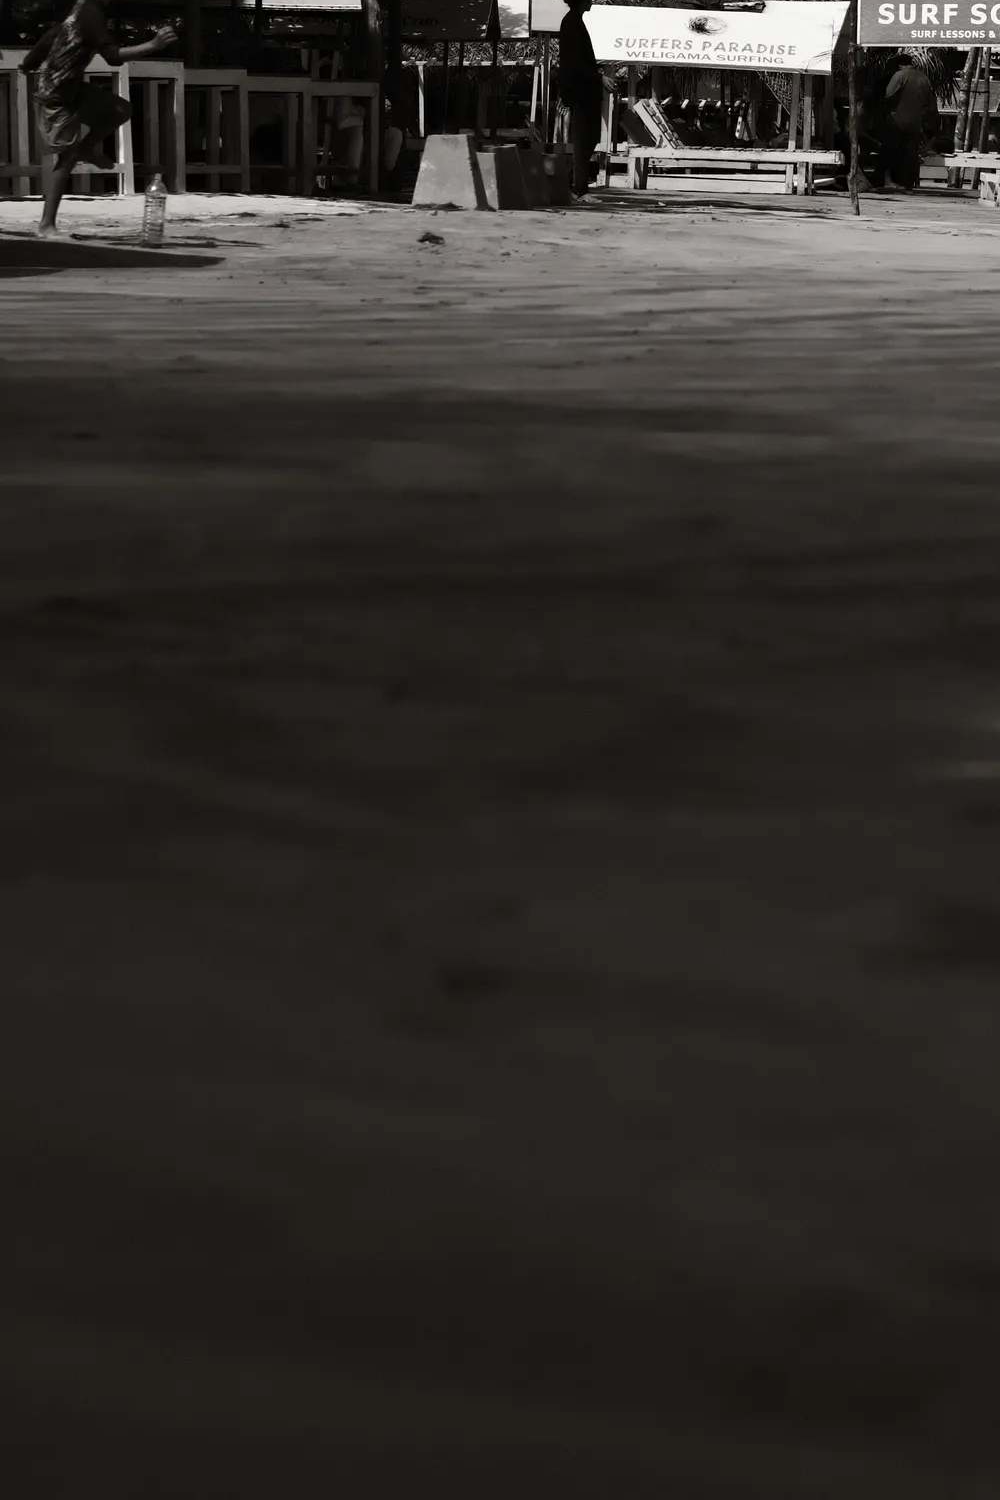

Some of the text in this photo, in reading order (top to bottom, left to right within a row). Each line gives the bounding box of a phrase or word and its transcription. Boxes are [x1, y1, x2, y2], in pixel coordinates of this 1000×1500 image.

[878, 3, 958, 25] SURF
[910, 30, 937, 38] SURF
[940, 30, 986, 38] LESSONS
[988, 30, 996, 38] &
[614, 37, 797, 56] SURFERS PARADISE
[626, 50, 785, 65] WELIGAMA SURFING
